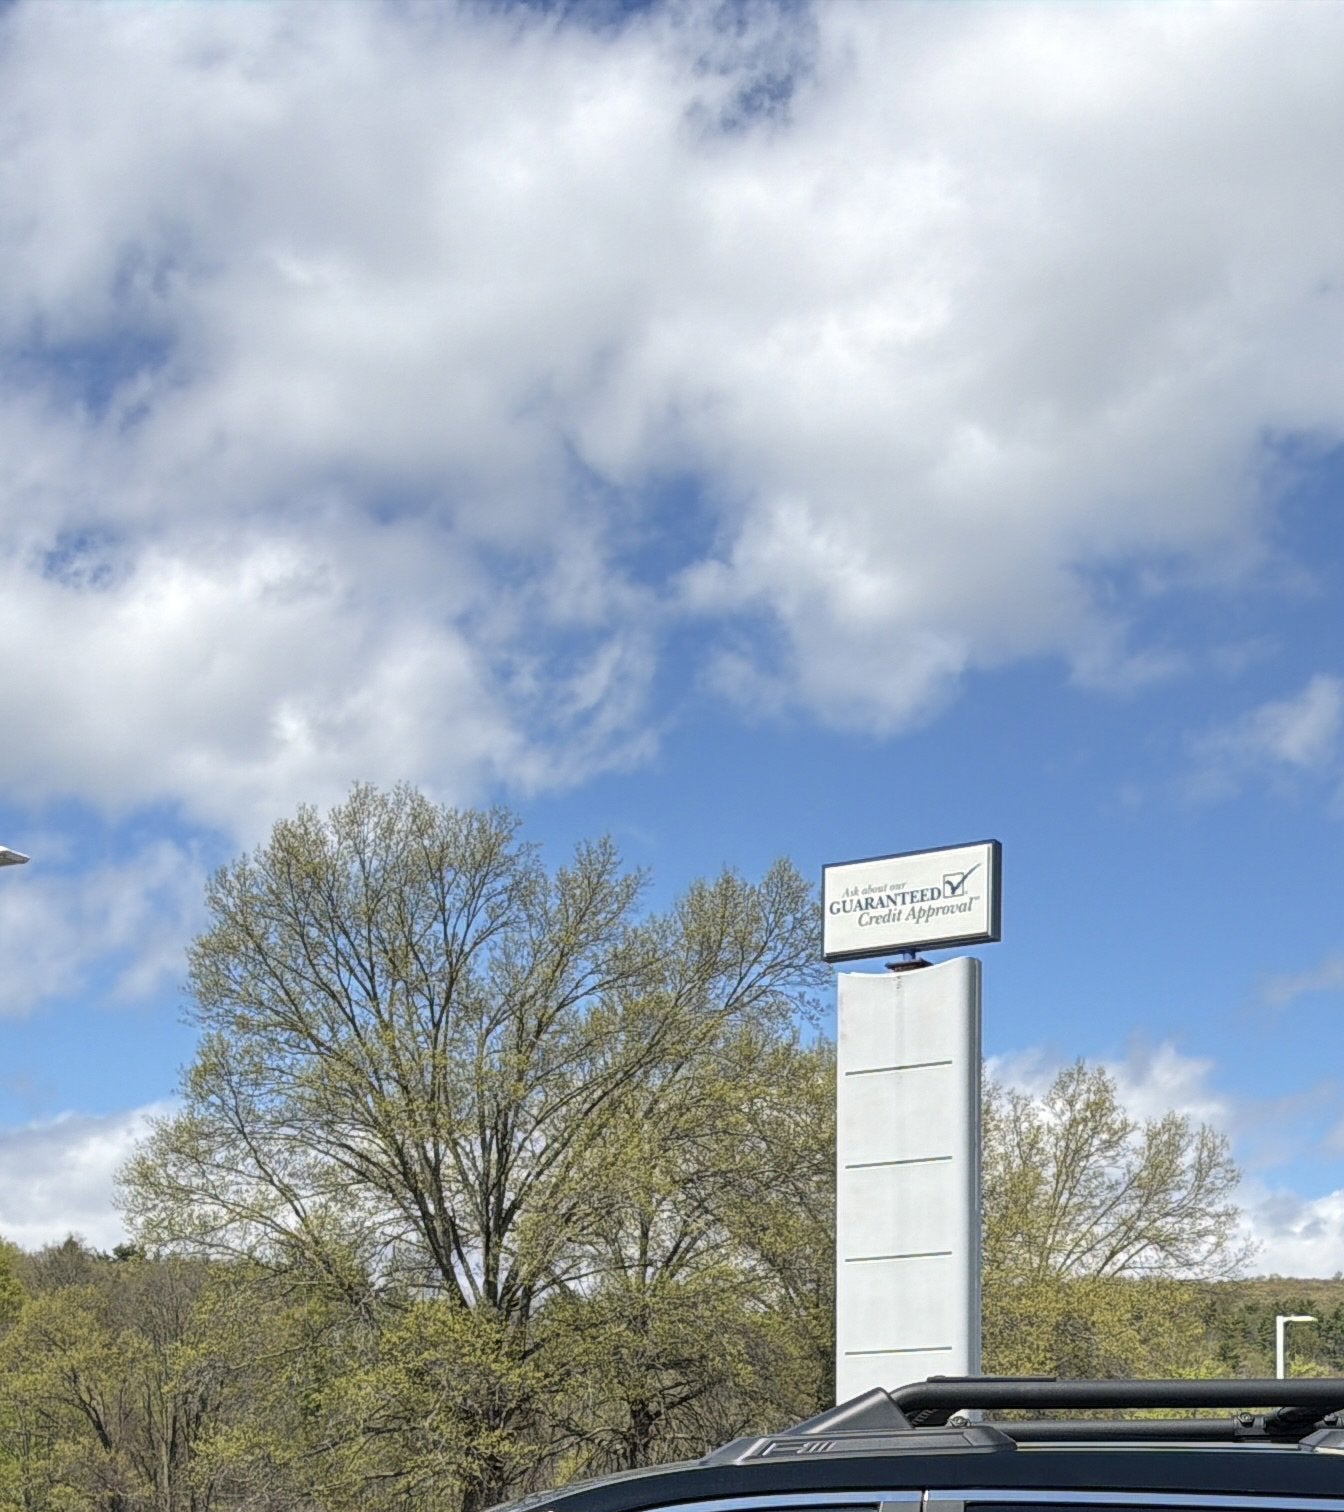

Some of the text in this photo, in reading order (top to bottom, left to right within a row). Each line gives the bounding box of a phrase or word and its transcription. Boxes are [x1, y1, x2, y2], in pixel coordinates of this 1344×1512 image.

[842, 881, 907, 898] Ask about our
[829, 887, 942, 915] GUARANTEED
[858, 908, 902, 927] Credit
